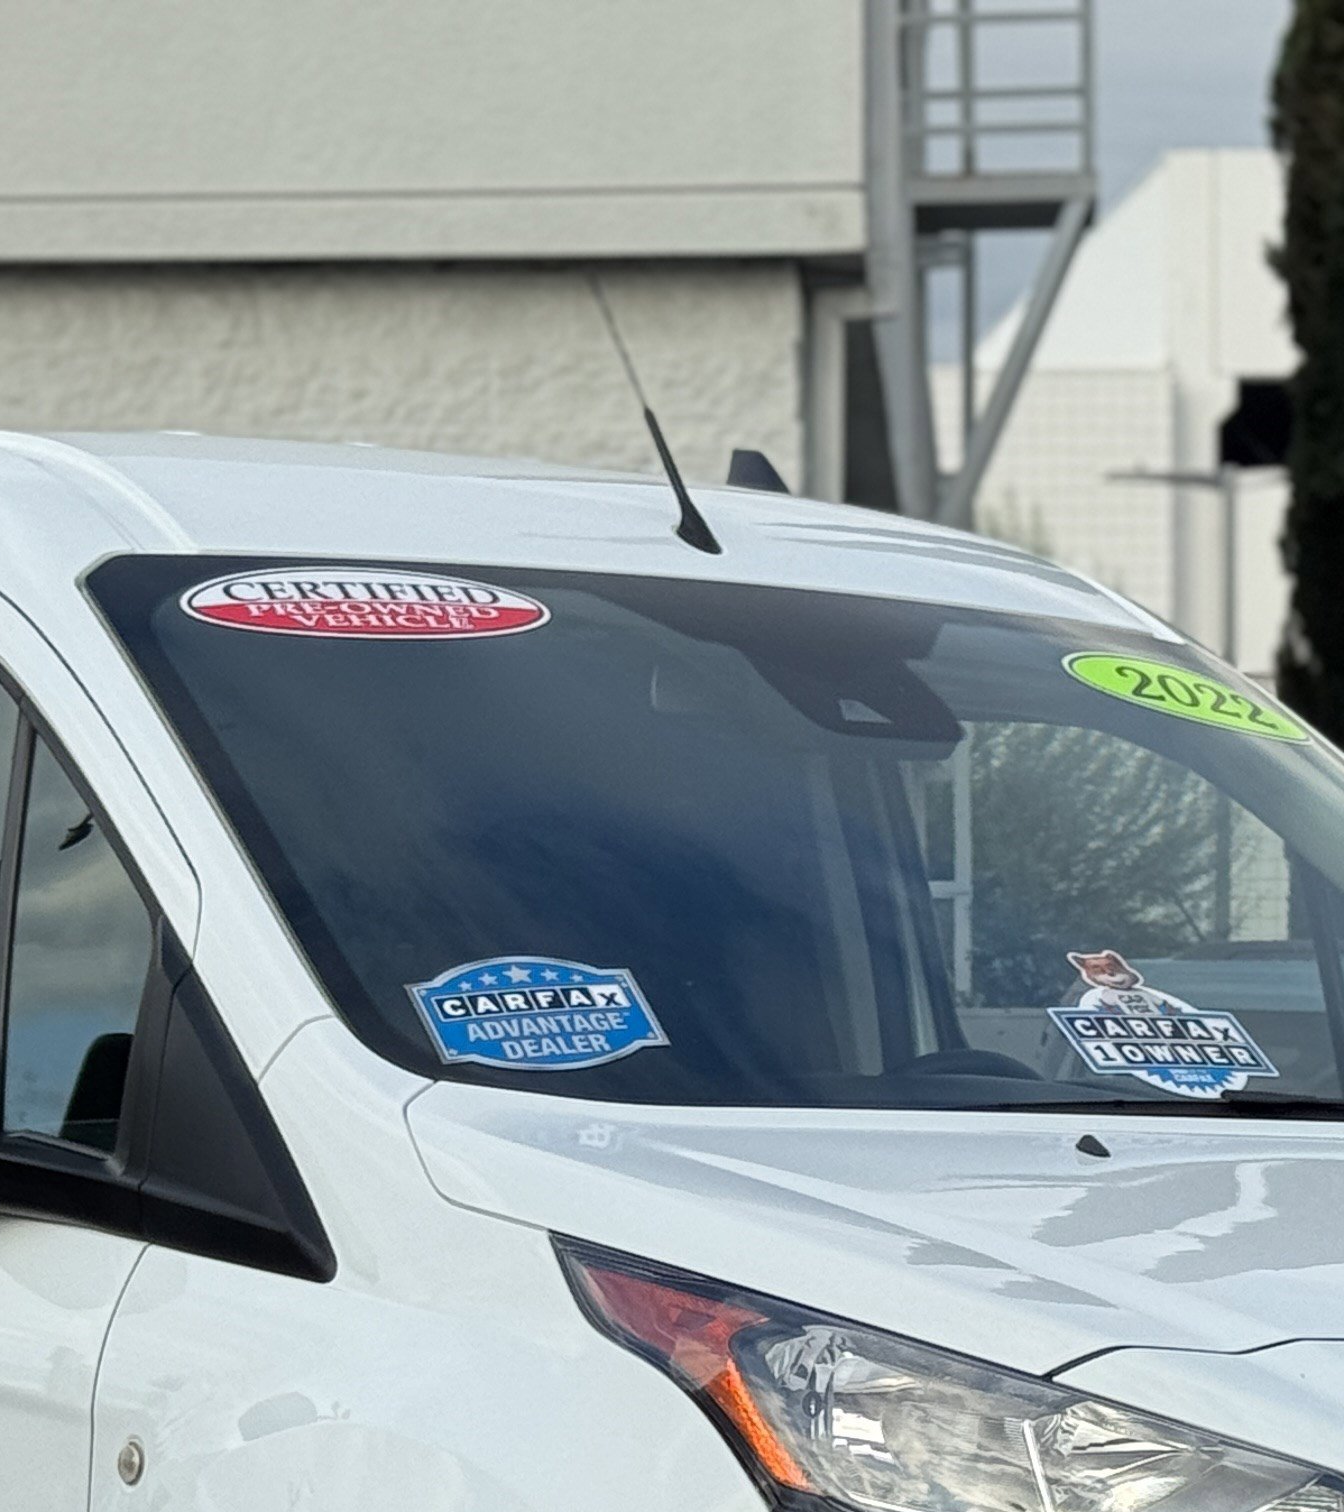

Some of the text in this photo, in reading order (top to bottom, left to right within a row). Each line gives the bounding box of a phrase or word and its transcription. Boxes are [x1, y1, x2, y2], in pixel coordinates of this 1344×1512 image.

[222, 581, 501, 605] CERTIFIED
[244, 602, 500, 619] PRE-OWNED
[288, 613, 475, 630] VEHICLE
[1114, 665, 1280, 731] 2022
[441, 987, 624, 1018] CARFAX
[465, 1012, 629, 1042] ADVANTAGE
[1072, 1016, 1239, 1042] CARFAX
[500, 1033, 612, 1060] DEALER
